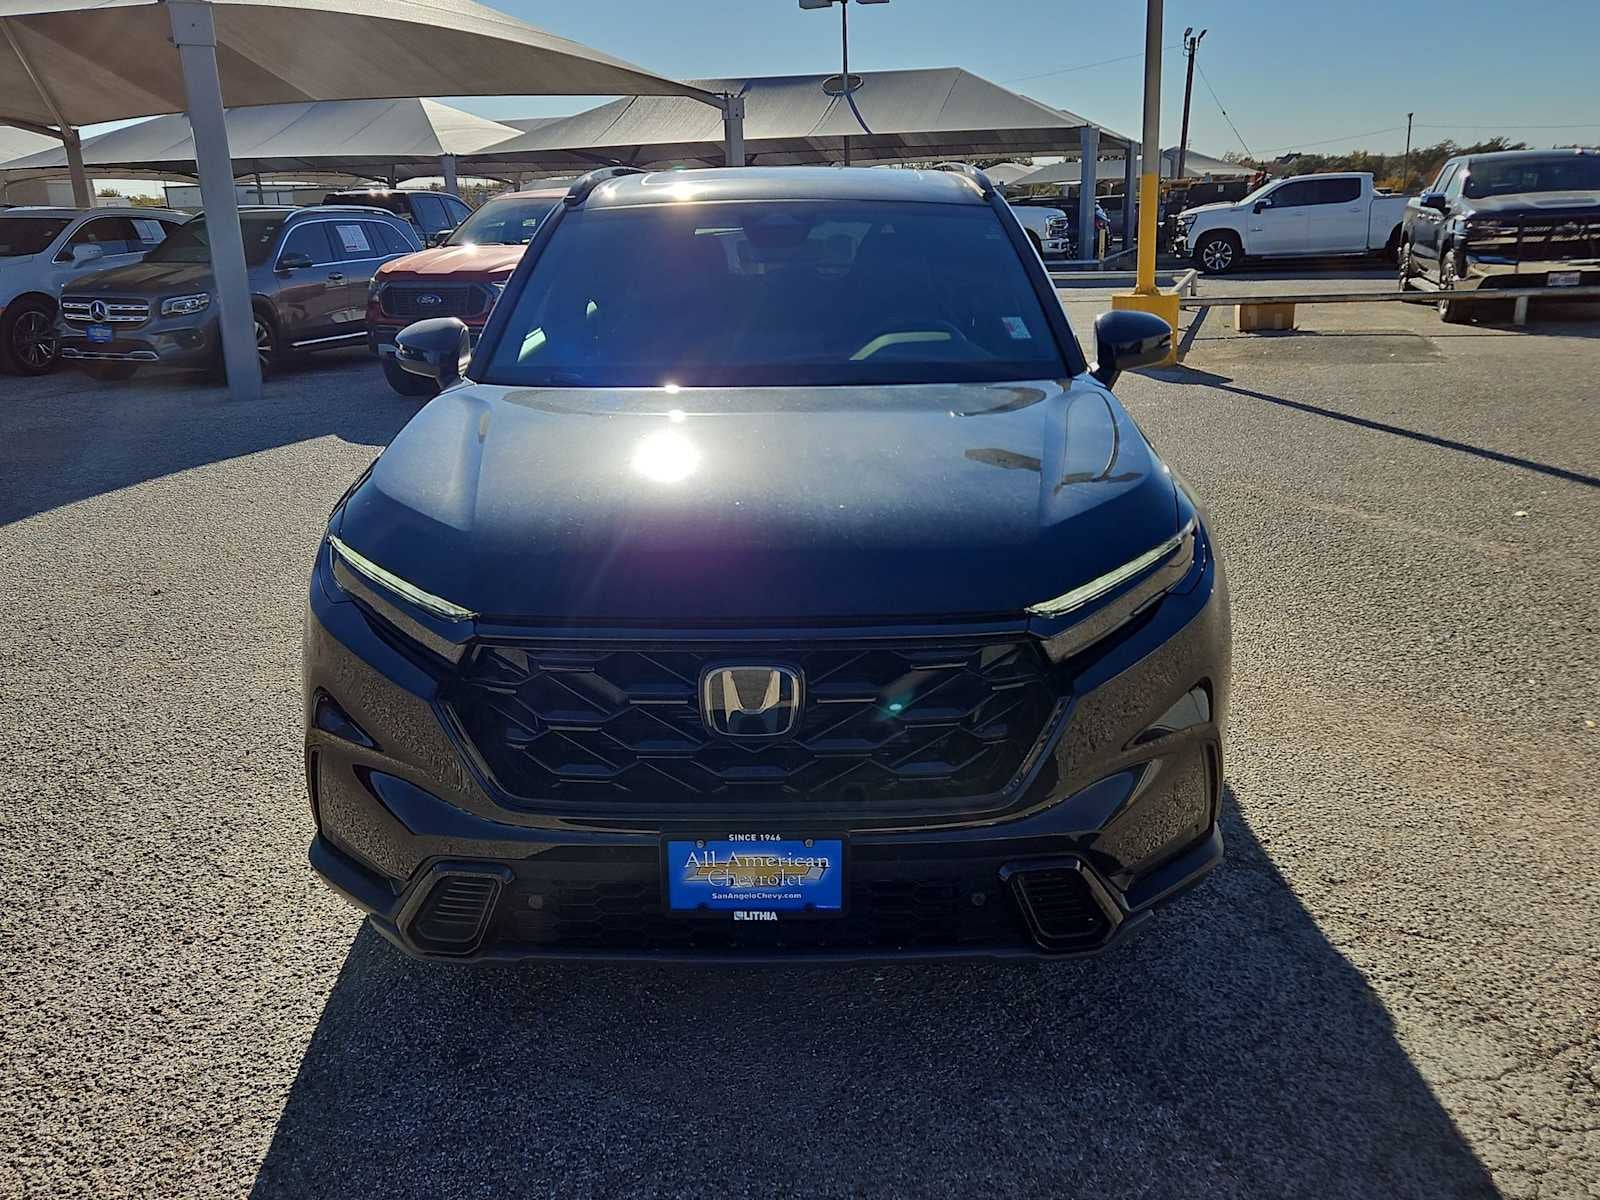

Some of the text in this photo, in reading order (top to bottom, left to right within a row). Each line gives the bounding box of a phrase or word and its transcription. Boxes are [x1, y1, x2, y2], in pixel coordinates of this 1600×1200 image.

[728, 833, 781, 842] SINCE 1946
[684, 850, 830, 868] All American
[707, 869, 804, 888] Chevrolet
[711, 892, 802, 900] SanAngeloChevy.com
[743, 911, 778, 921] LITHIA
